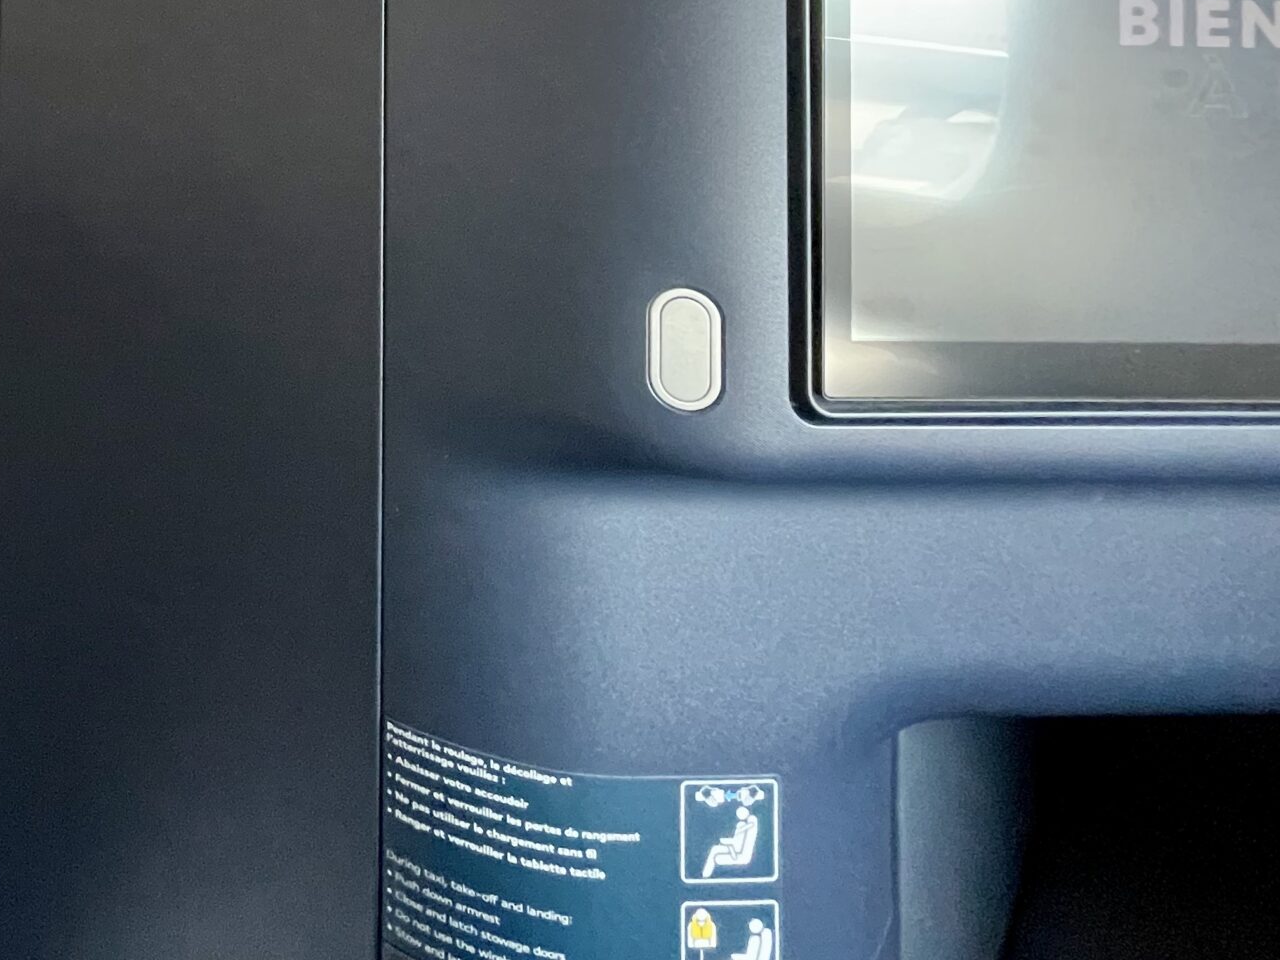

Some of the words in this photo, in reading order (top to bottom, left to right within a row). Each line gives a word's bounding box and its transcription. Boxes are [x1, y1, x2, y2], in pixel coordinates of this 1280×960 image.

[386, 721, 429, 747] Pendant
[431, 740, 441, 752] le
[489, 759, 500, 771] le
[502, 763, 558, 785] décollage
[559, 776, 573, 787] et
[457, 763, 499, 783] veuillez
[395, 756, 441, 781] Abaisser
[442, 776, 472, 793] votre
[474, 787, 529, 810] accoudoir
[395, 773, 431, 796] Fermer
[432, 791, 445, 803] et
[447, 797, 504, 822] verrouiller
[506, 813, 522, 827] les
[524, 821, 562, 837] portes
[564, 826, 580, 839] de
[581, 831, 641, 844] rangement
[395, 790, 410, 805] Ne
[411, 801, 431, 815] pas
[432, 809, 471, 830] utiliser
[473, 822, 484, 835] le
[486, 828, 555, 854] chargement
[557, 847, 583, 858] sans
[395, 808, 432, 833] Ranger
[433, 828, 446, 840] et
[447, 834, 505, 860] verrouiller
[506, 852, 518, 864] la
[519, 857, 568, 876] tablette
[569, 867, 607, 881] tactile
[386, 849, 421, 877] During
[500, 900, 523, 913] and
[422, 888, 454, 907] down
[455, 902, 500, 926] armrest
[395, 908, 411, 923] Do
[412, 919, 432, 935] not
[433, 930, 454, 945] use
[455, 938, 476, 954] the
[424, 944, 446, 960] and
[425, 908, 447, 923] and
[449, 916, 479, 937] latch
[480, 930, 530, 954] stowage
